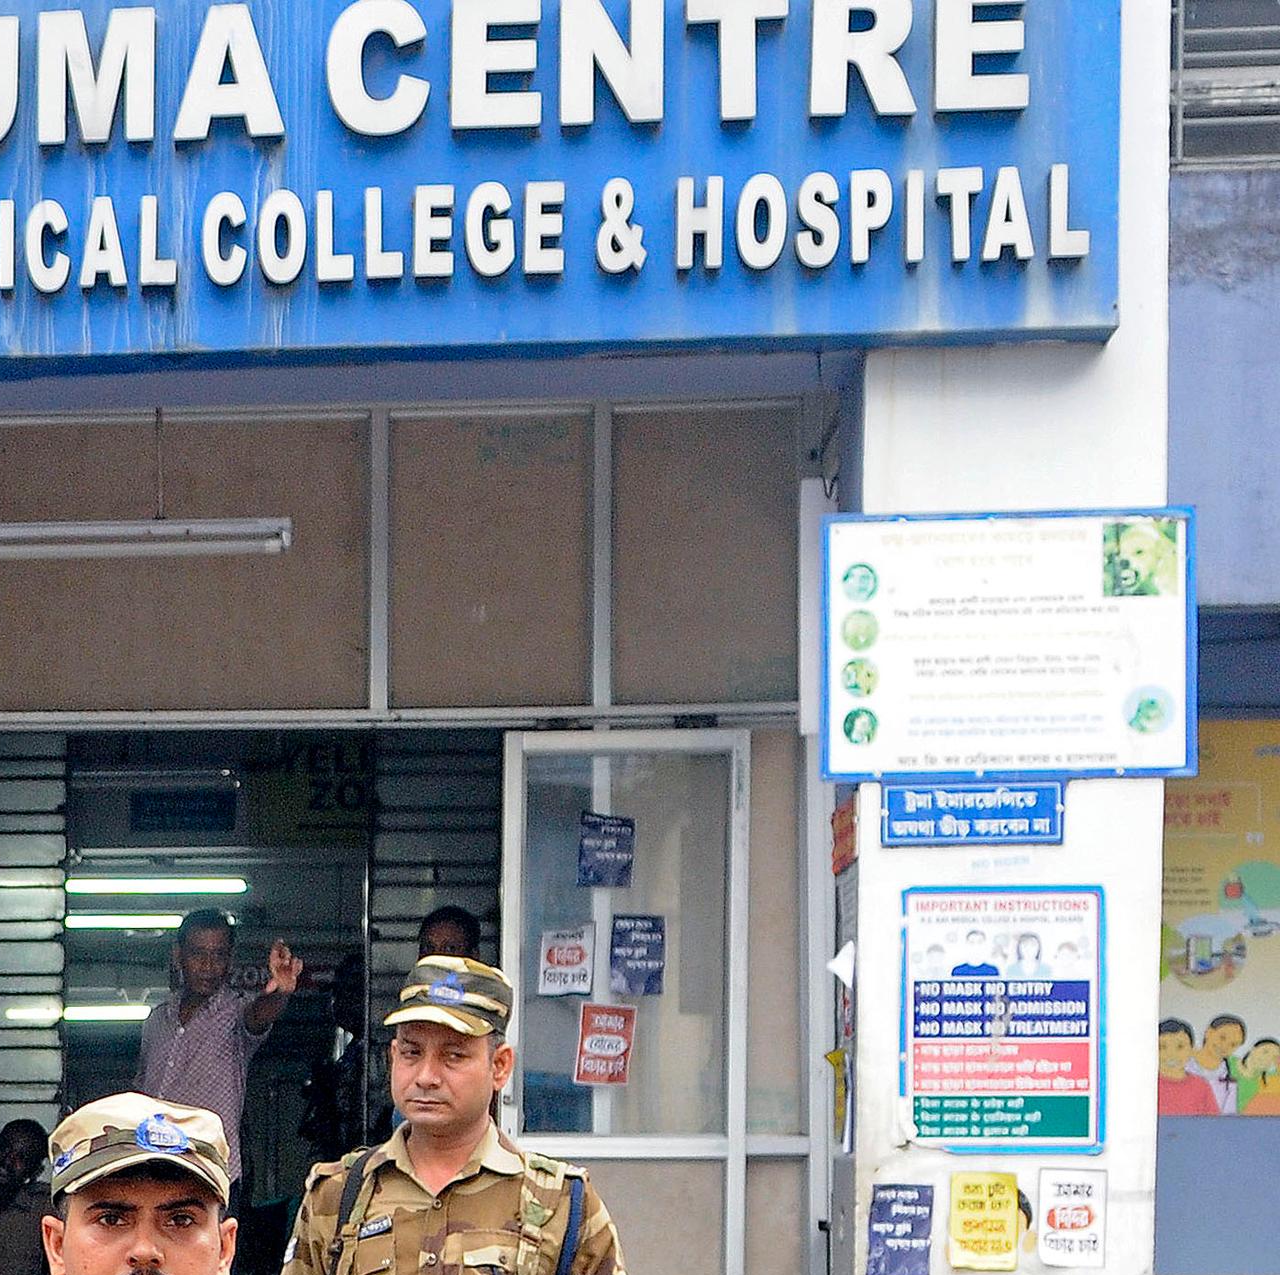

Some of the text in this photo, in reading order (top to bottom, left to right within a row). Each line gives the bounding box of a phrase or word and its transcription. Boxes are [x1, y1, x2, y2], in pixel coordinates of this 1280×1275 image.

[326, 0, 1032, 138] CENTRE
[202, 180, 566, 286] COLLEGE
[595, 176, 648, 275] &
[676, 163, 1091, 271] HOSPITAL
[916, 899, 1090, 913] IMPORTANT INSTRUCTIONS
[920, 983, 1054, 996] NO MASK NO ENTRY
[920, 1001, 1086, 1015] NO MASK NO ADMISSION
[920, 1021, 940, 1035] NO
[942, 1021, 983, 1035] MASK
[1009, 1020, 1088, 1035] TREATMENT
